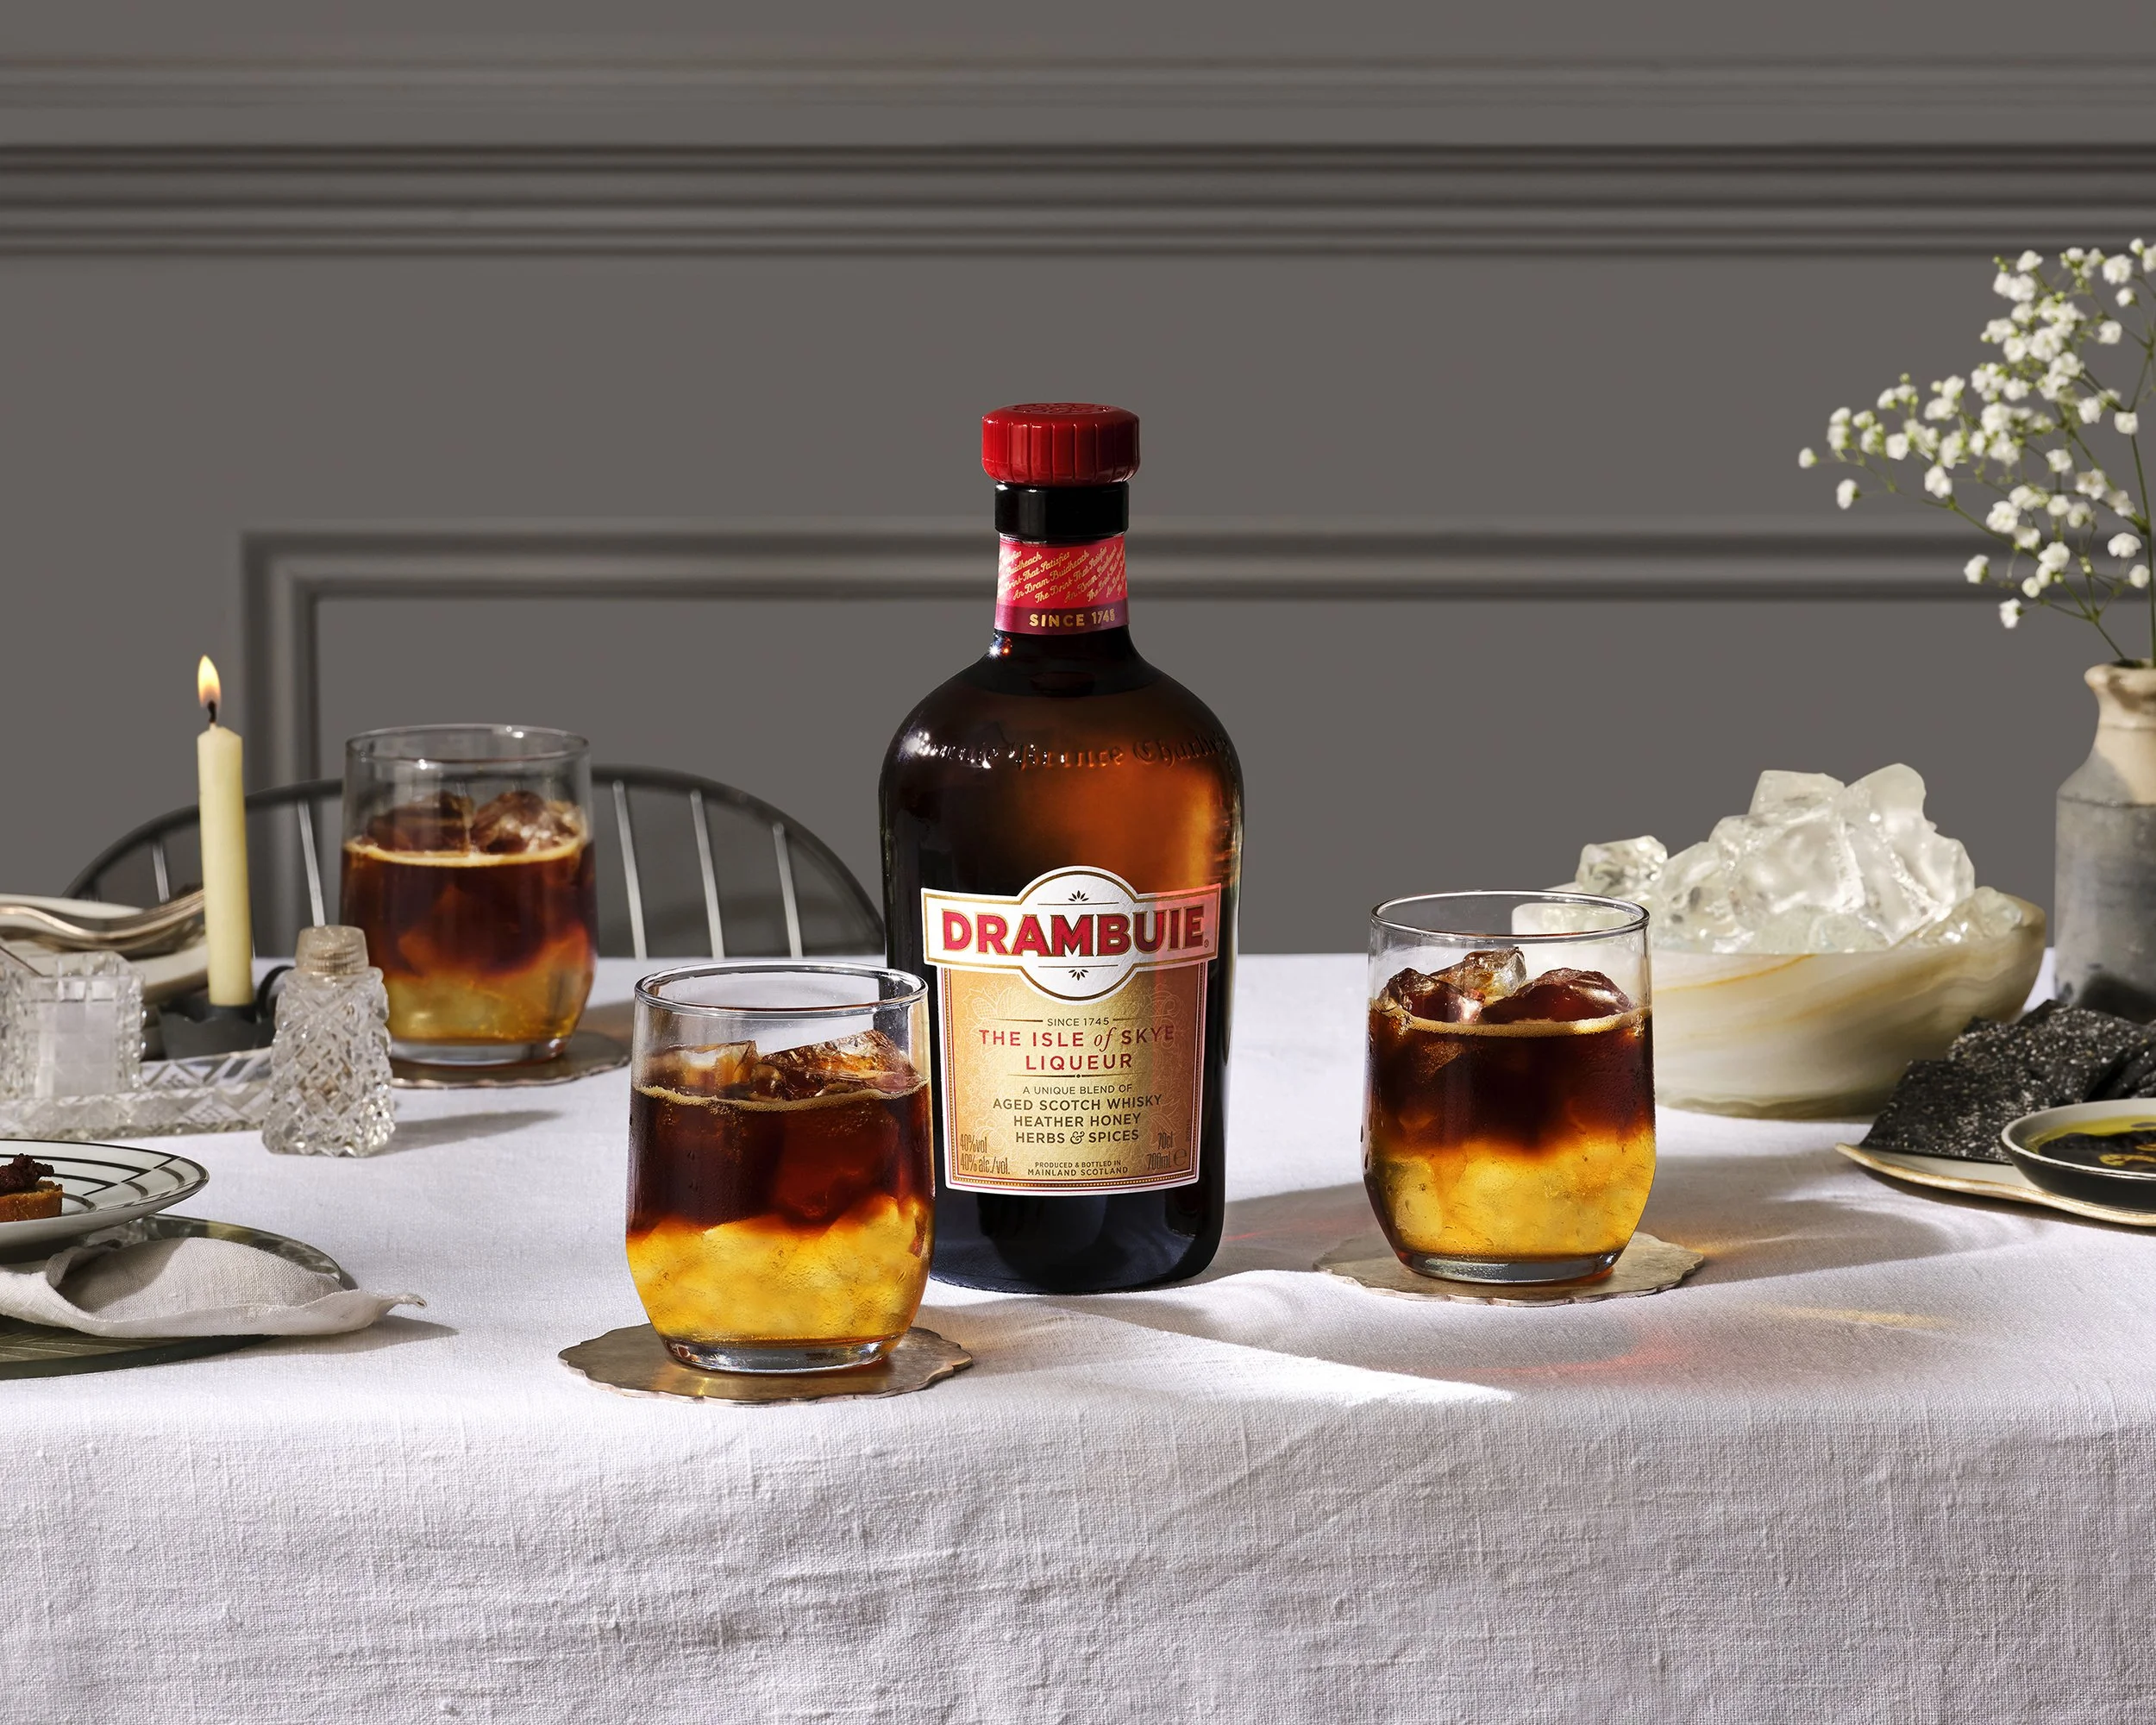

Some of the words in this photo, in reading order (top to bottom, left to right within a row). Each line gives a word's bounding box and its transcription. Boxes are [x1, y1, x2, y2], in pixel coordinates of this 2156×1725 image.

[1022, 568, 1040, 582] That
[1040, 551, 1070, 573] Satisfies
[1024, 578, 1050, 594] Dram
[1050, 549, 1090, 581] Buidheach
[1035, 591, 1050, 604] The
[1050, 577, 1073, 596] Drink
[1029, 613, 1085, 627] SINCE
[941, 904, 1205, 957] DRAMBUIE
[1047, 1018, 1080, 1026] SINCE
[1083, 1017, 1110, 1026] 1745
[979, 1030, 1021, 1046] THE
[1032, 1032, 1084, 1047] ISLE
[1094, 1026, 1117, 1051] of
[1120, 1026, 1174, 1045] SKYE
[1025, 1053, 1132, 1070] LIQUEUR
[1023, 1086, 1031, 1095] A
[1034, 1086, 1075, 1095] UNIQUE
[1080, 1085, 1115, 1095] BLEND
[1119, 1084, 1132, 1093] OF
[993, 1098, 1033, 1111] AGED
[1039, 1099, 1100, 1111] SCOTCH
[1107, 1094, 1163, 1110] WHISKY
[1013, 1115, 1084, 1127] HEATHER
[1090, 1113, 1141, 1126] HONEY
[1016, 1132, 1065, 1144] HERBS
[1070, 1131, 1085, 1145] &
[1088, 1129, 1139, 1143] SPICES
[1081, 1166, 1128, 1176] SCOTLAND
